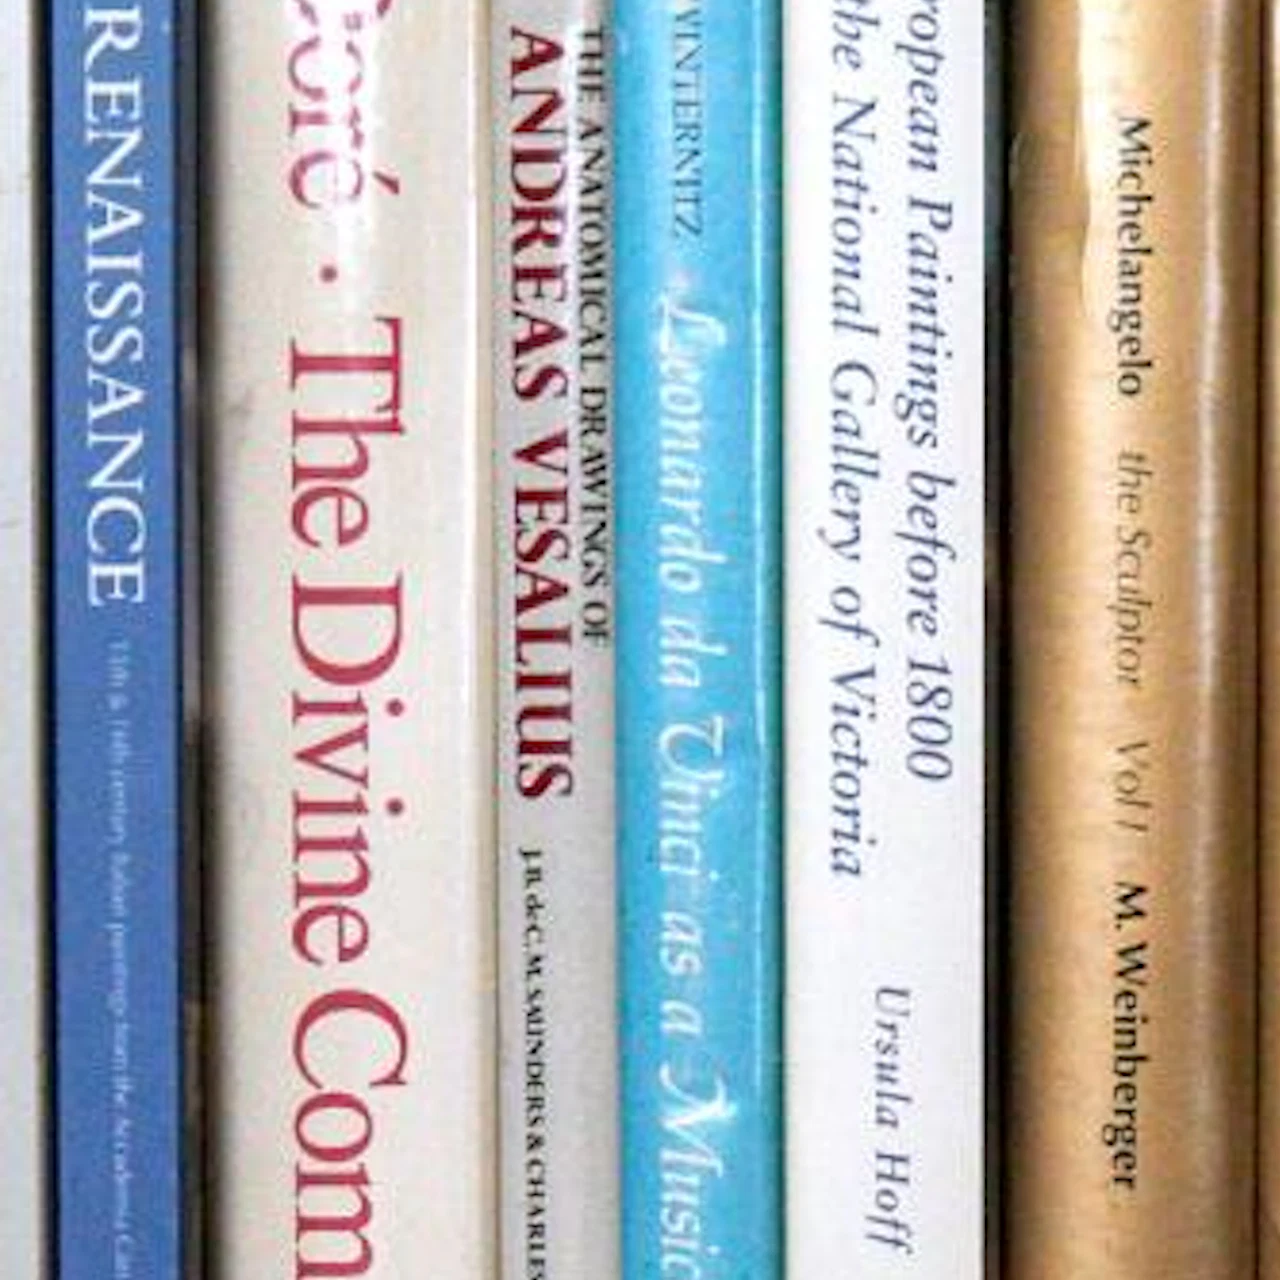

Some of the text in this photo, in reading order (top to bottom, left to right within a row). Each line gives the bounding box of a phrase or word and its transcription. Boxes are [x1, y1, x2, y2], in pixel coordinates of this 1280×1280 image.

[84, 6, 144, 606] RENAISSANCE
[831, 93, 880, 338] National
[895, 195, 953, 450] Paintings
[1108, 116, 1154, 397] Michelangelo
[288, 315, 406, 549] The
[509, 26, 574, 800] ANDREAS VESALIUS
[577, 28, 610, 649] THE ANATOMICAL DRAWINGS OF
[656, 288, 728, 592] Leonardo
[818, 361, 880, 563] Gallery
[895, 470, 954, 637] before
[1117, 451, 1152, 515] the
[657, 615, 728, 688] da
[819, 586, 880, 647] of
[906, 655, 953, 781] 1800
[1107, 524, 1152, 692] Sculptor
[288, 572, 406, 966] Divine
[656, 715, 730, 881] Vinci
[830, 664, 878, 878] Victoria
[656, 911, 702, 976] as
[656, 1001, 702, 1037] a
[1104, 881, 1149, 1192] M. Weinberger
[865, 985, 913, 1256] Ursula Hoff
